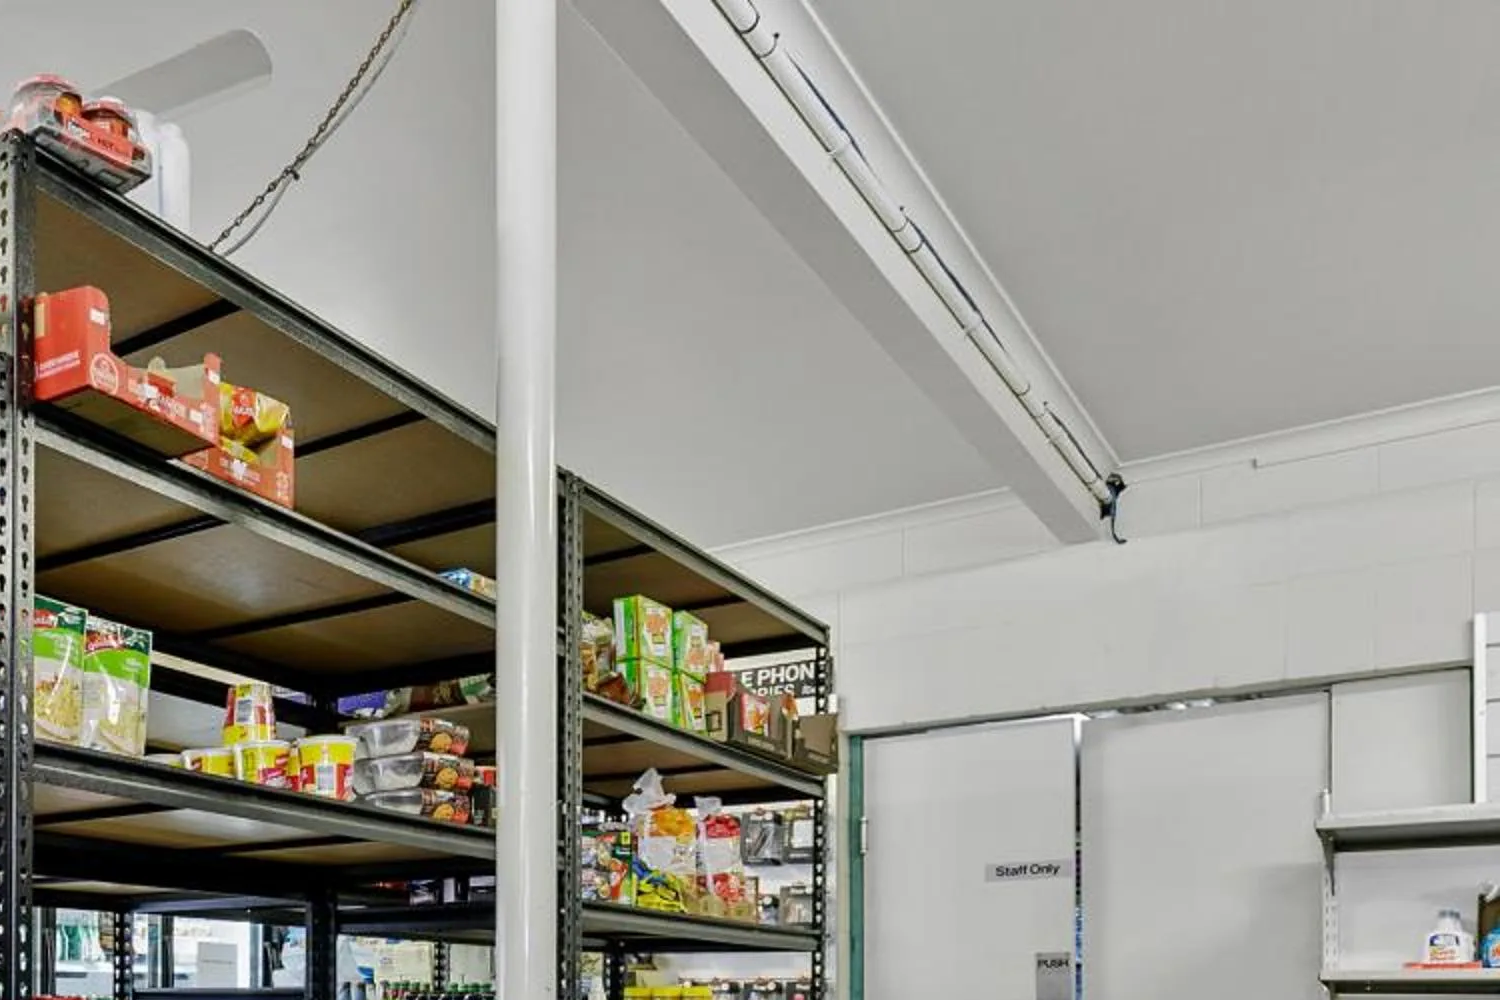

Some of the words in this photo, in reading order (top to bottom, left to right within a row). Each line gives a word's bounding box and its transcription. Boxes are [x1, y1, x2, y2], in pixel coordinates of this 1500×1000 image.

[756, 661, 816, 687] PHON
[995, 864, 1029, 878] Staff
[1029, 863, 1060, 877] Only
[1036, 958, 1070, 970] PUSH
